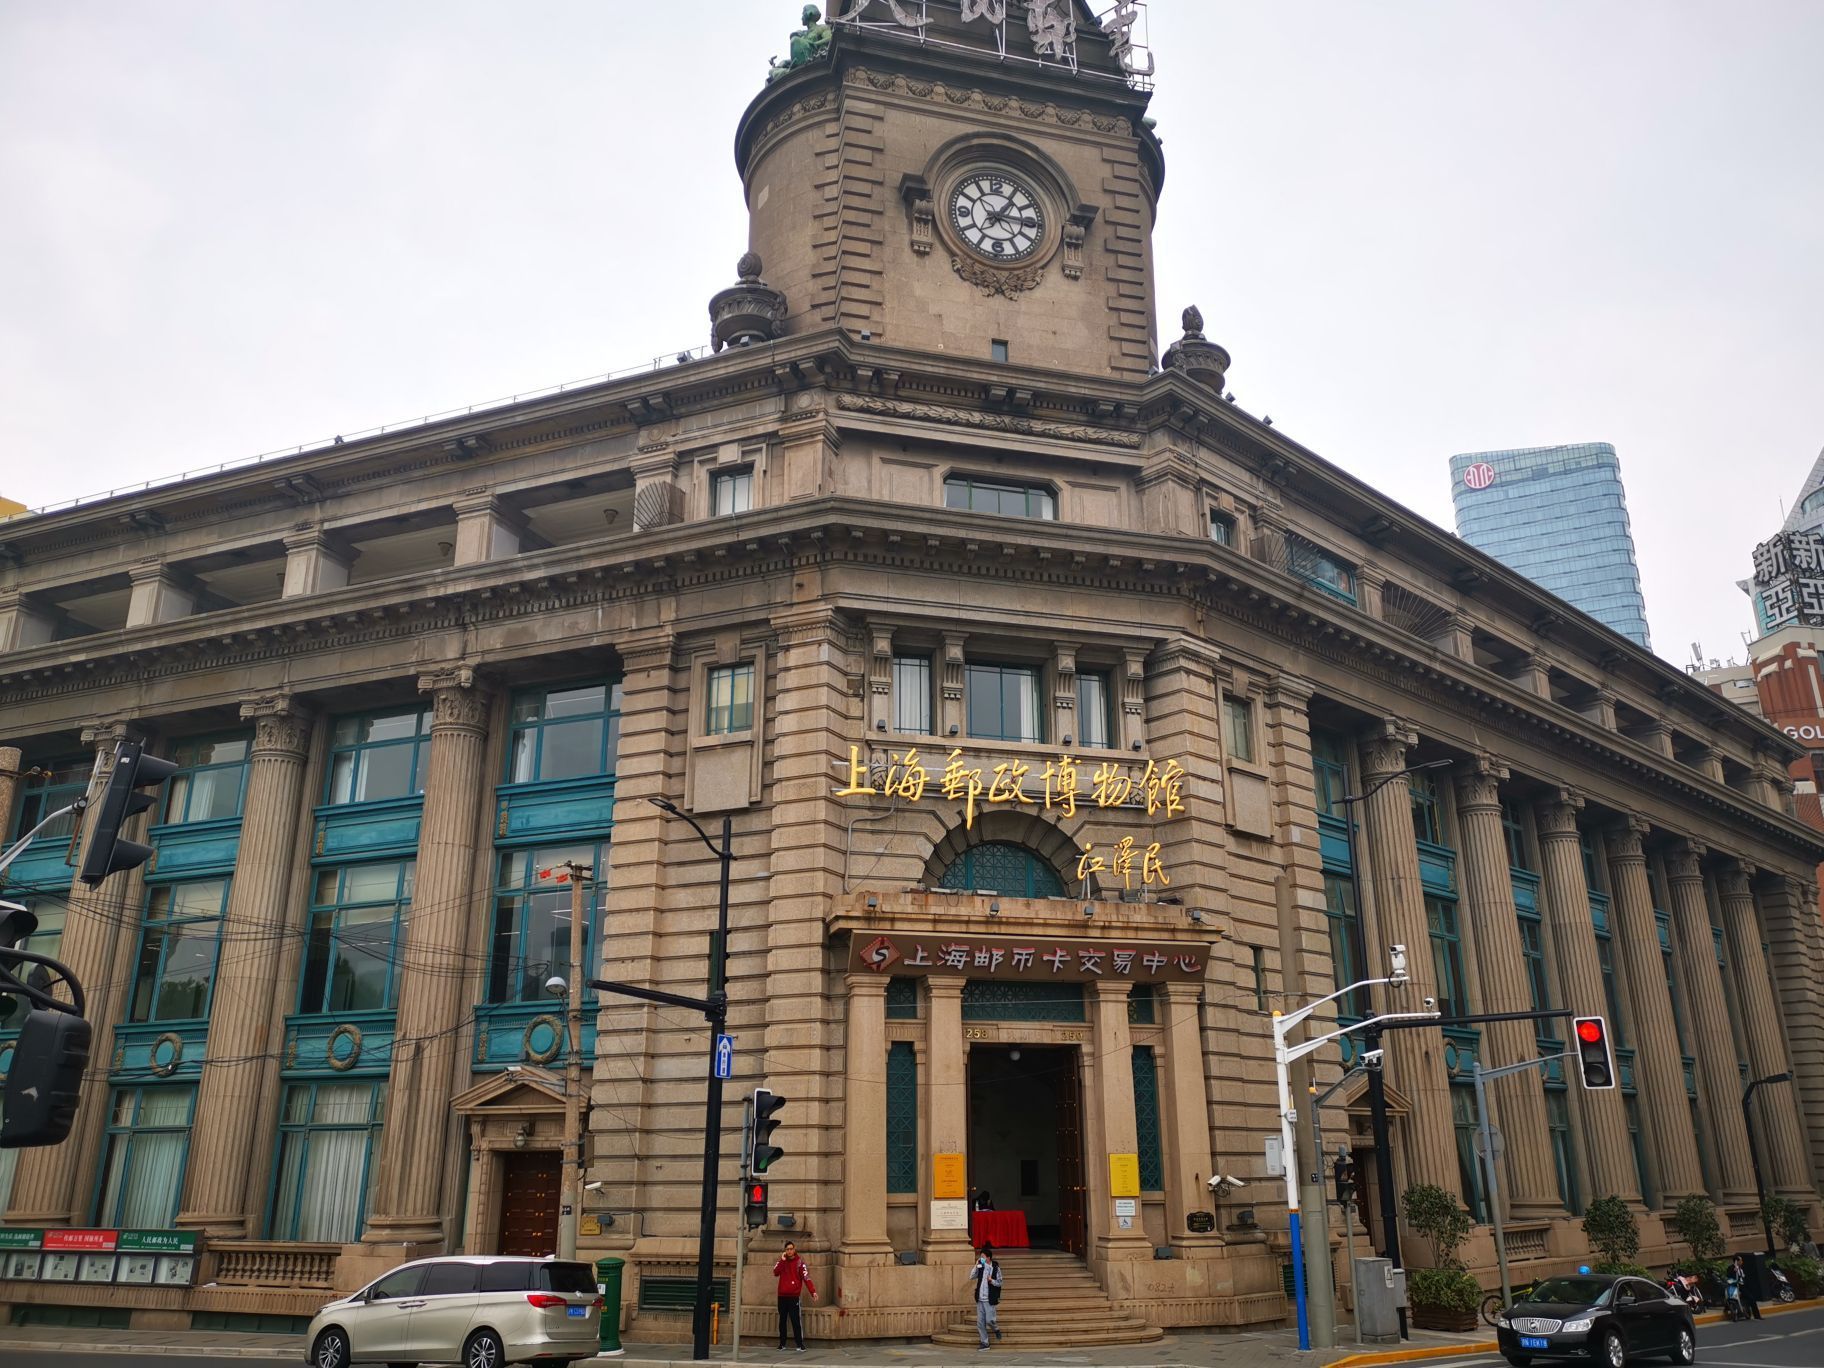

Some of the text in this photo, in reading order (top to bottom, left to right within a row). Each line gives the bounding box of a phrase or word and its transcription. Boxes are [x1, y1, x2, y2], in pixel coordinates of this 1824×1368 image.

[904, 943, 1201, 974] 上海邮币卡交易中心
